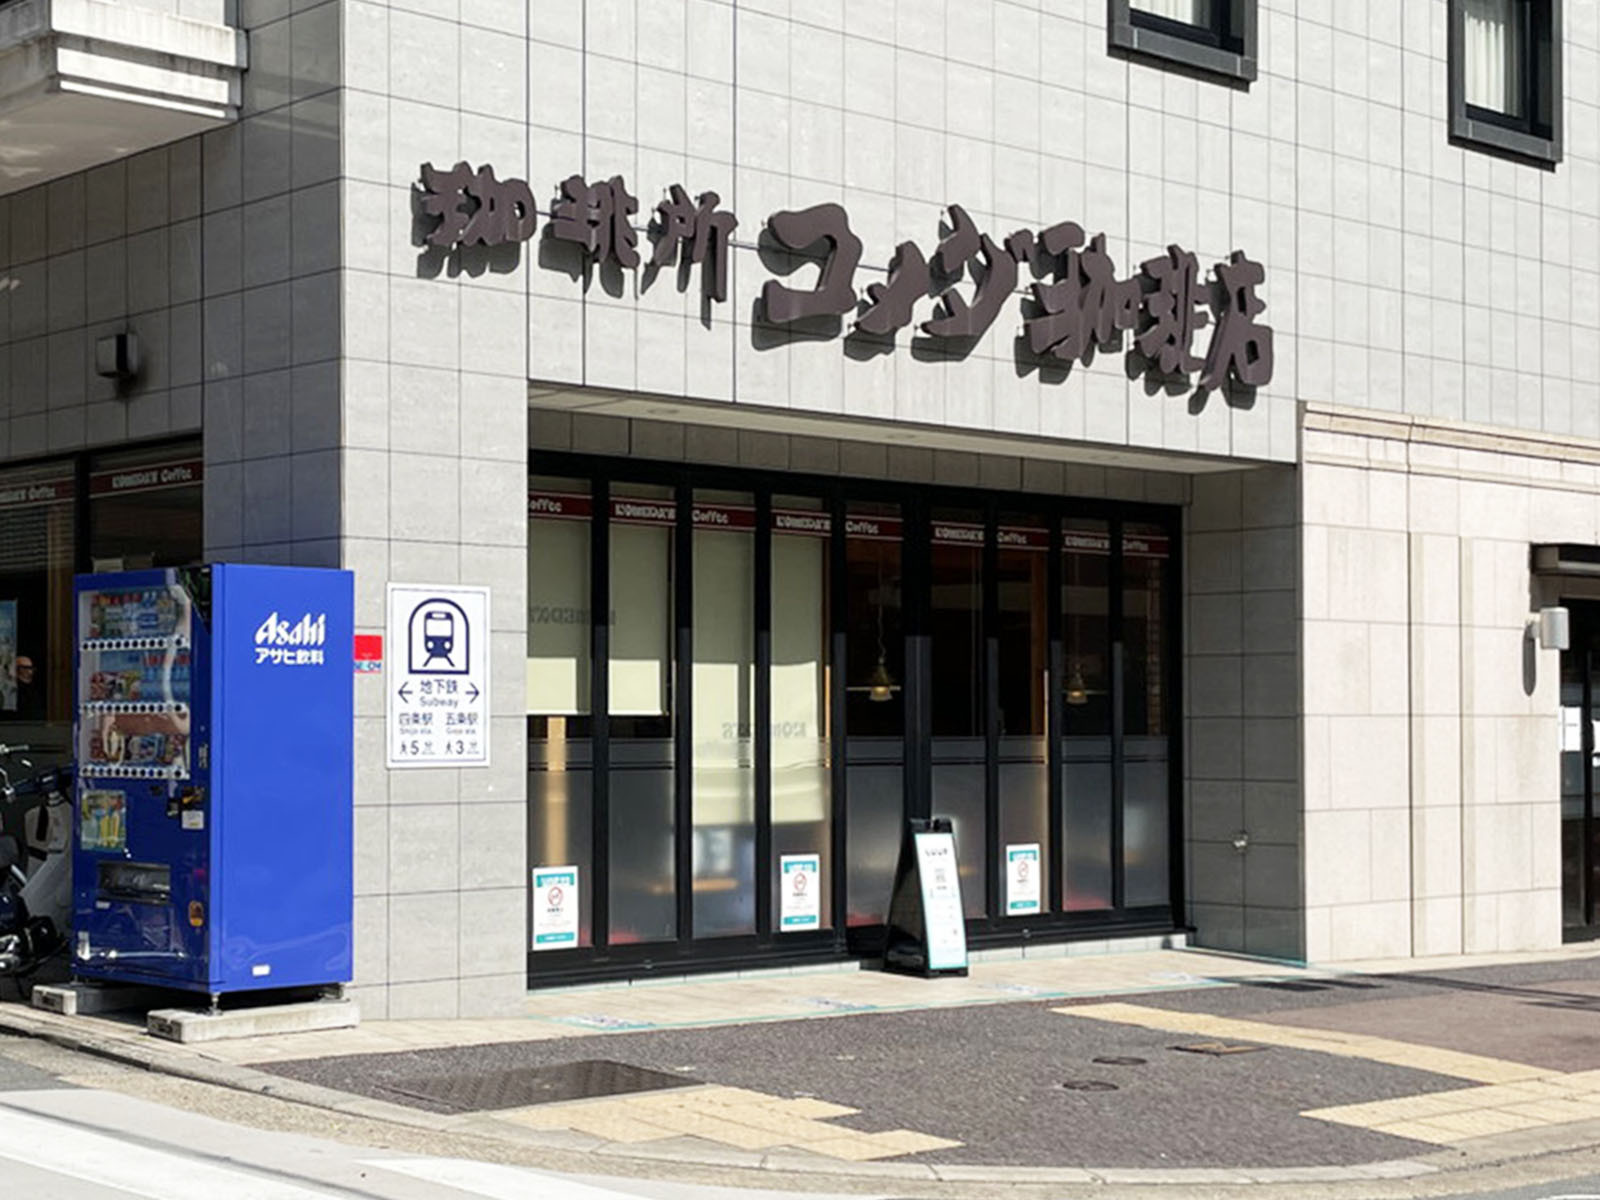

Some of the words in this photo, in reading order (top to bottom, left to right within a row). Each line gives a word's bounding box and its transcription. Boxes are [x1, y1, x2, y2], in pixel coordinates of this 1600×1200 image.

[255, 611, 326, 646] Asahi
[255, 647, 324, 665] アサヒ飲料
[420, 679, 458, 695] 地下鉄
[419, 695, 459, 708] Subway
